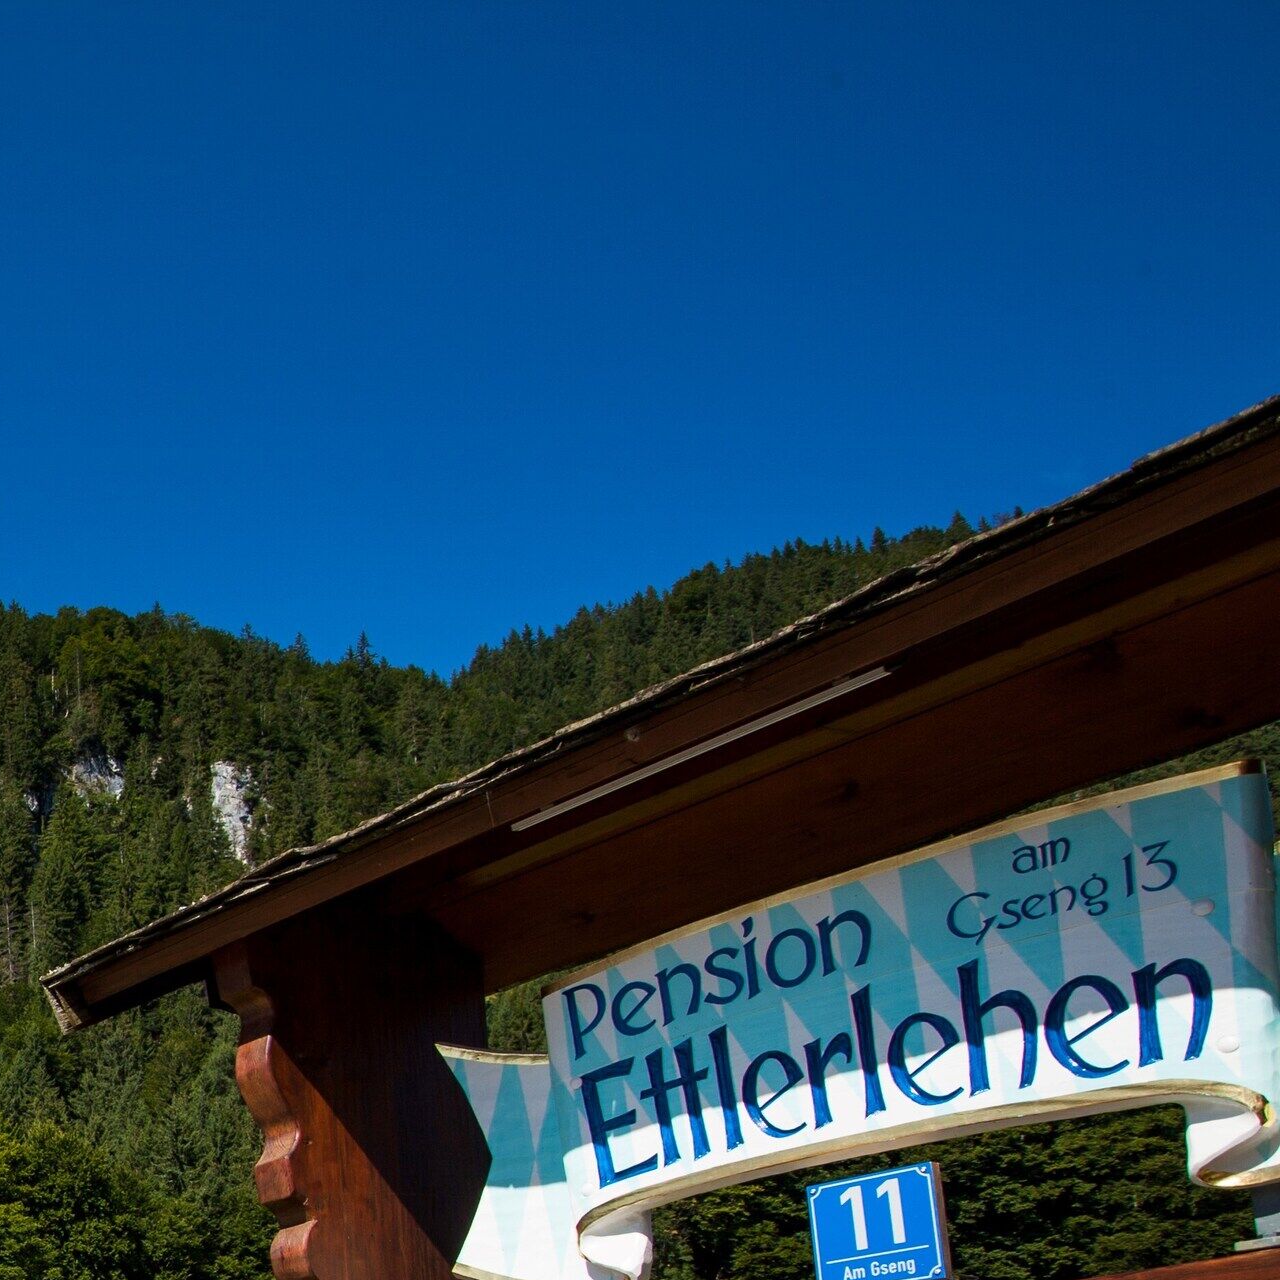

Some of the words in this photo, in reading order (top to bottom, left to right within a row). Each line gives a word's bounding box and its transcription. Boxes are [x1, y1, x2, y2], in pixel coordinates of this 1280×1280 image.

[946, 872, 1109, 945] Gseng
[1121, 840, 1178, 898] 13
[1011, 836, 1071, 874] am
[561, 909, 872, 1061] Pension
[580, 957, 1214, 1190] Ettlerlehen
[839, 1177, 907, 1251] 11
[843, 1265, 867, 1280] Am
[870, 1258, 917, 1277] Gseng
